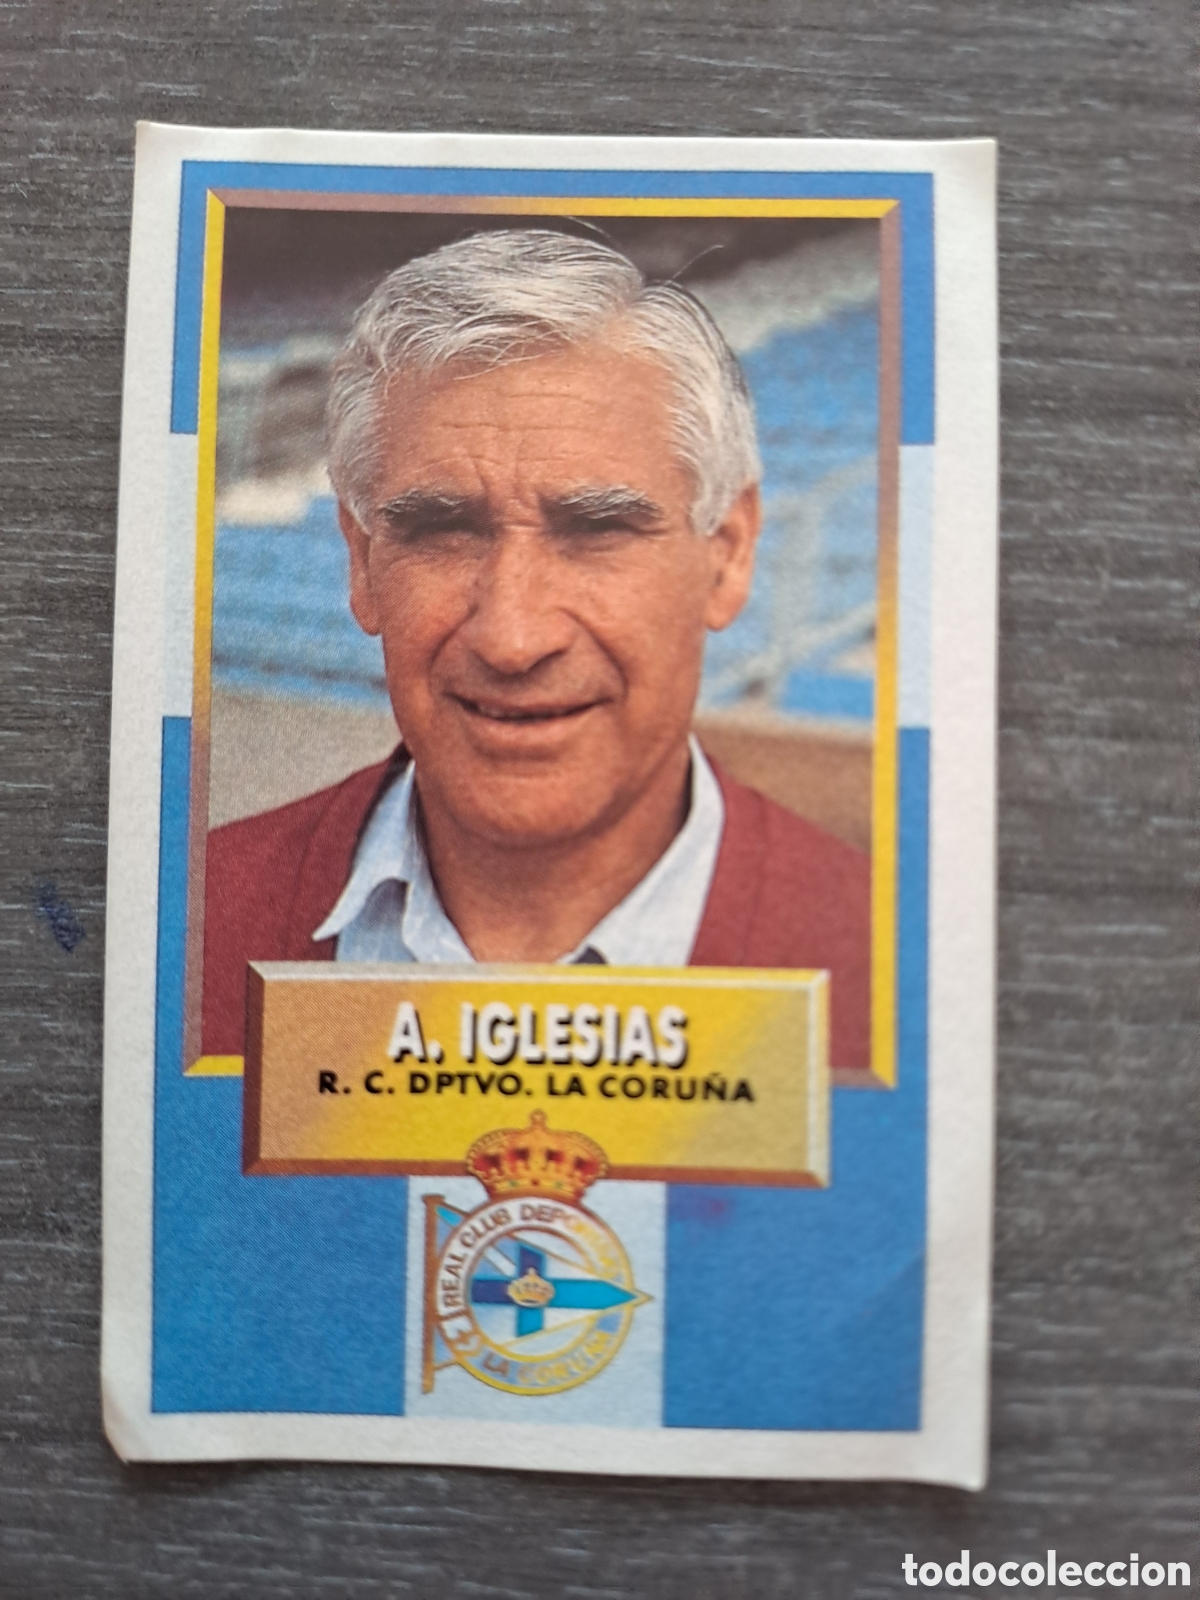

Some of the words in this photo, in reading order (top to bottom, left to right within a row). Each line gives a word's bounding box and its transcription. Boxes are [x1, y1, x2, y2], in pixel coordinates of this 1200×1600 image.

[387, 1000, 443, 1063] A.
[460, 1001, 688, 1069] IGLESIAS
[318, 1070, 352, 1094] R.
[364, 1071, 395, 1095] C.
[408, 1072, 532, 1097] DPTVO.
[546, 1074, 587, 1097] LA
[599, 1073, 756, 1102] CORUÑA
[441, 1251, 467, 1309] REAL
[459, 1208, 513, 1249] CLUB
